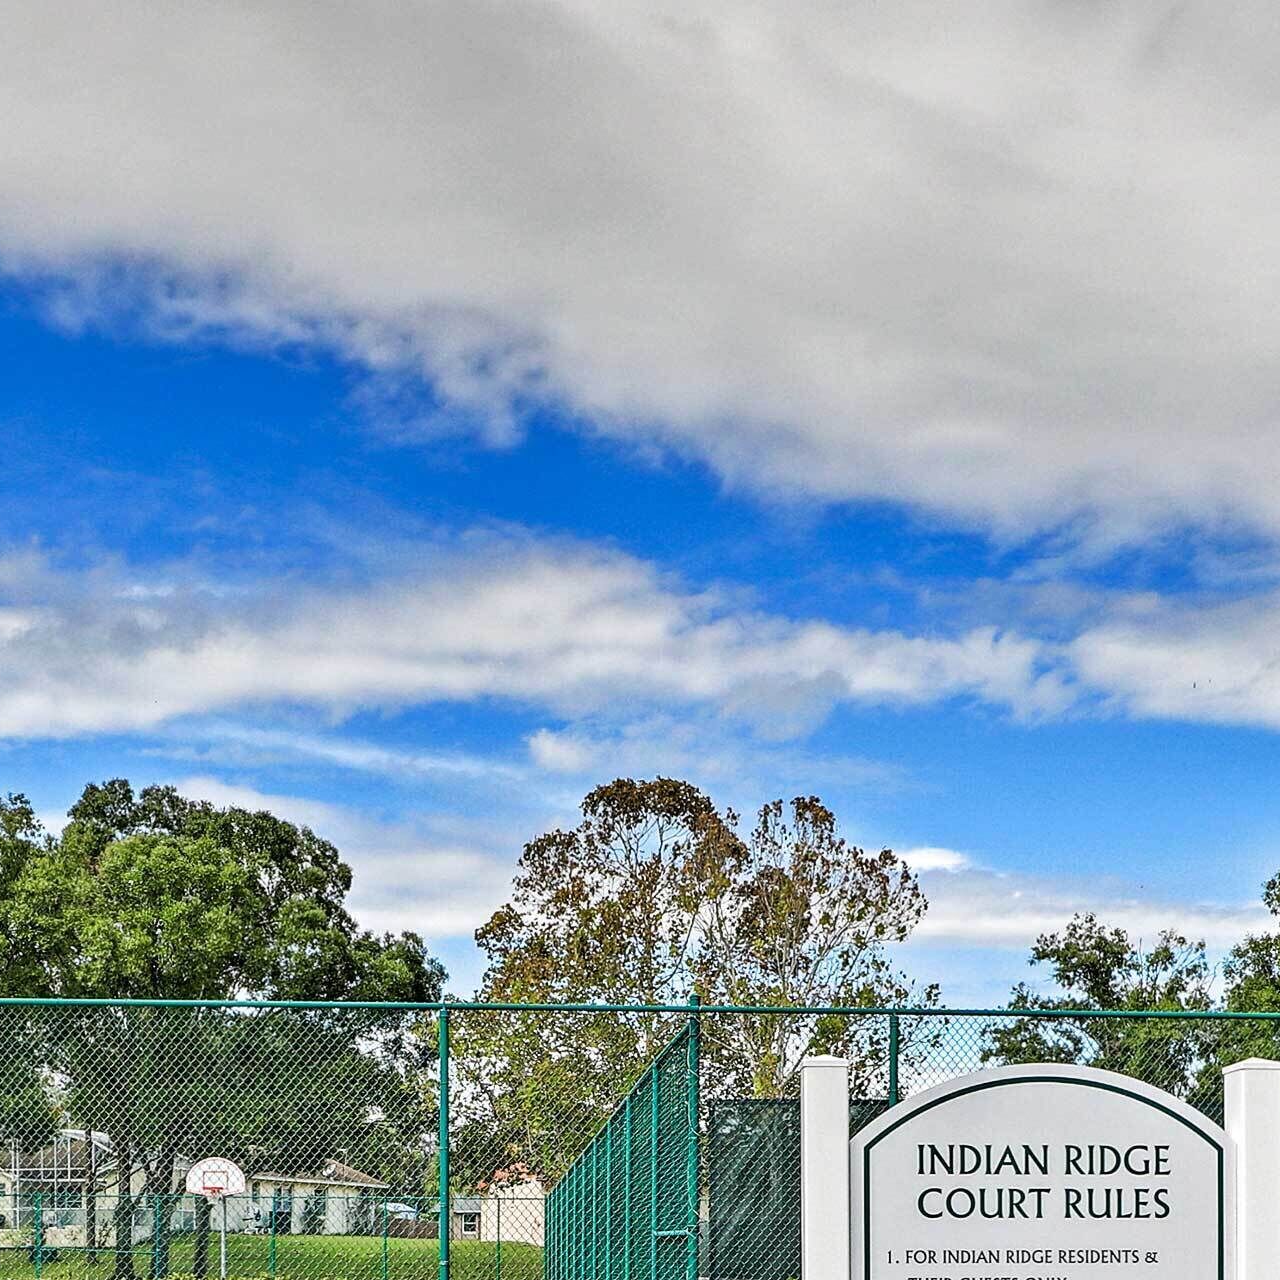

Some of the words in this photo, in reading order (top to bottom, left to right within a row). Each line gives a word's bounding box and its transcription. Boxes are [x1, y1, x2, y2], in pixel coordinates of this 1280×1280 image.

[917, 1144, 1049, 1176] INDIAN
[1064, 1144, 1172, 1176] RIDGE
[917, 1187, 1052, 1219] COURT
[1064, 1188, 1170, 1219] RULES
[887, 1249, 900, 1265] 1.
[905, 1249, 938, 1265] FOR
[942, 1249, 1000, 1264] INDIAN
[1006, 1249, 1053, 1264] RIDGE
[1058, 1249, 1140, 1264] RESIDENTS
[1144, 1251, 1159, 1264] &
